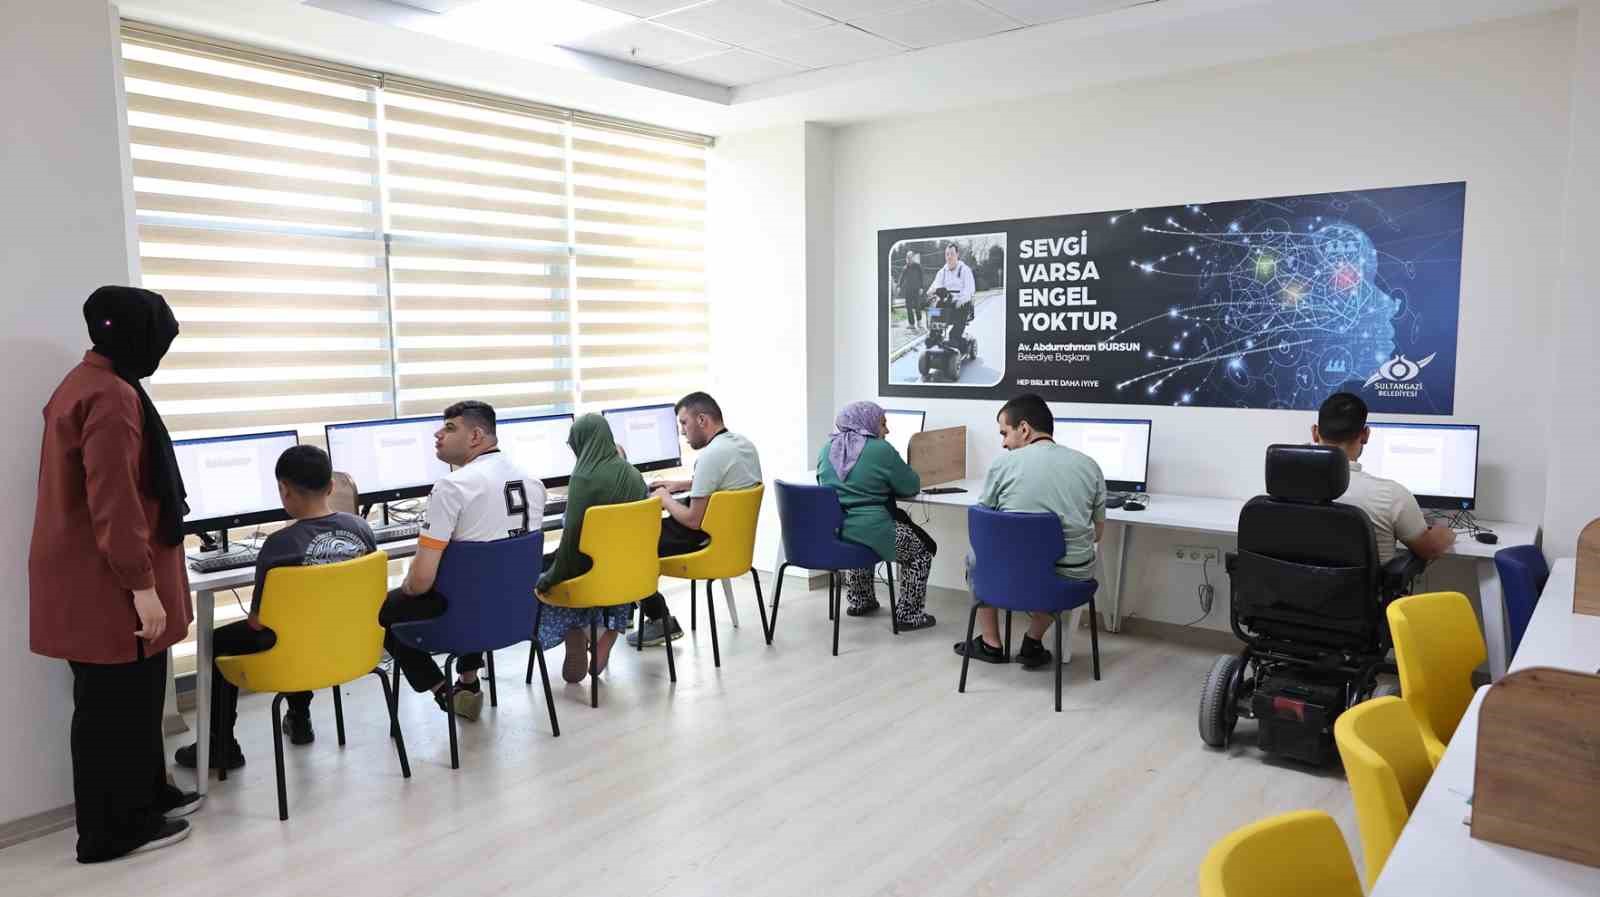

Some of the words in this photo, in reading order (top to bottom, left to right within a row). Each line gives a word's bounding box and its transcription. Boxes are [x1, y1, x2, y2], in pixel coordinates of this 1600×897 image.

[1019, 229, 1088, 259] SEVGİ
[1018, 261, 1100, 283] VARSA
[1018, 286, 1097, 307] ENGEL
[1018, 311, 1118, 332] YOKTUR
[1017, 342, 1032, 351] Av.
[1032, 342, 1097, 351] Abdurrahman
[1098, 342, 1141, 351] DURSUN
[1017, 352, 1054, 362] Belediye
[1055, 352, 1090, 363] Başkanı
[1060, 379, 1081, 387] DAHA
[504, 480, 530, 537] 9
